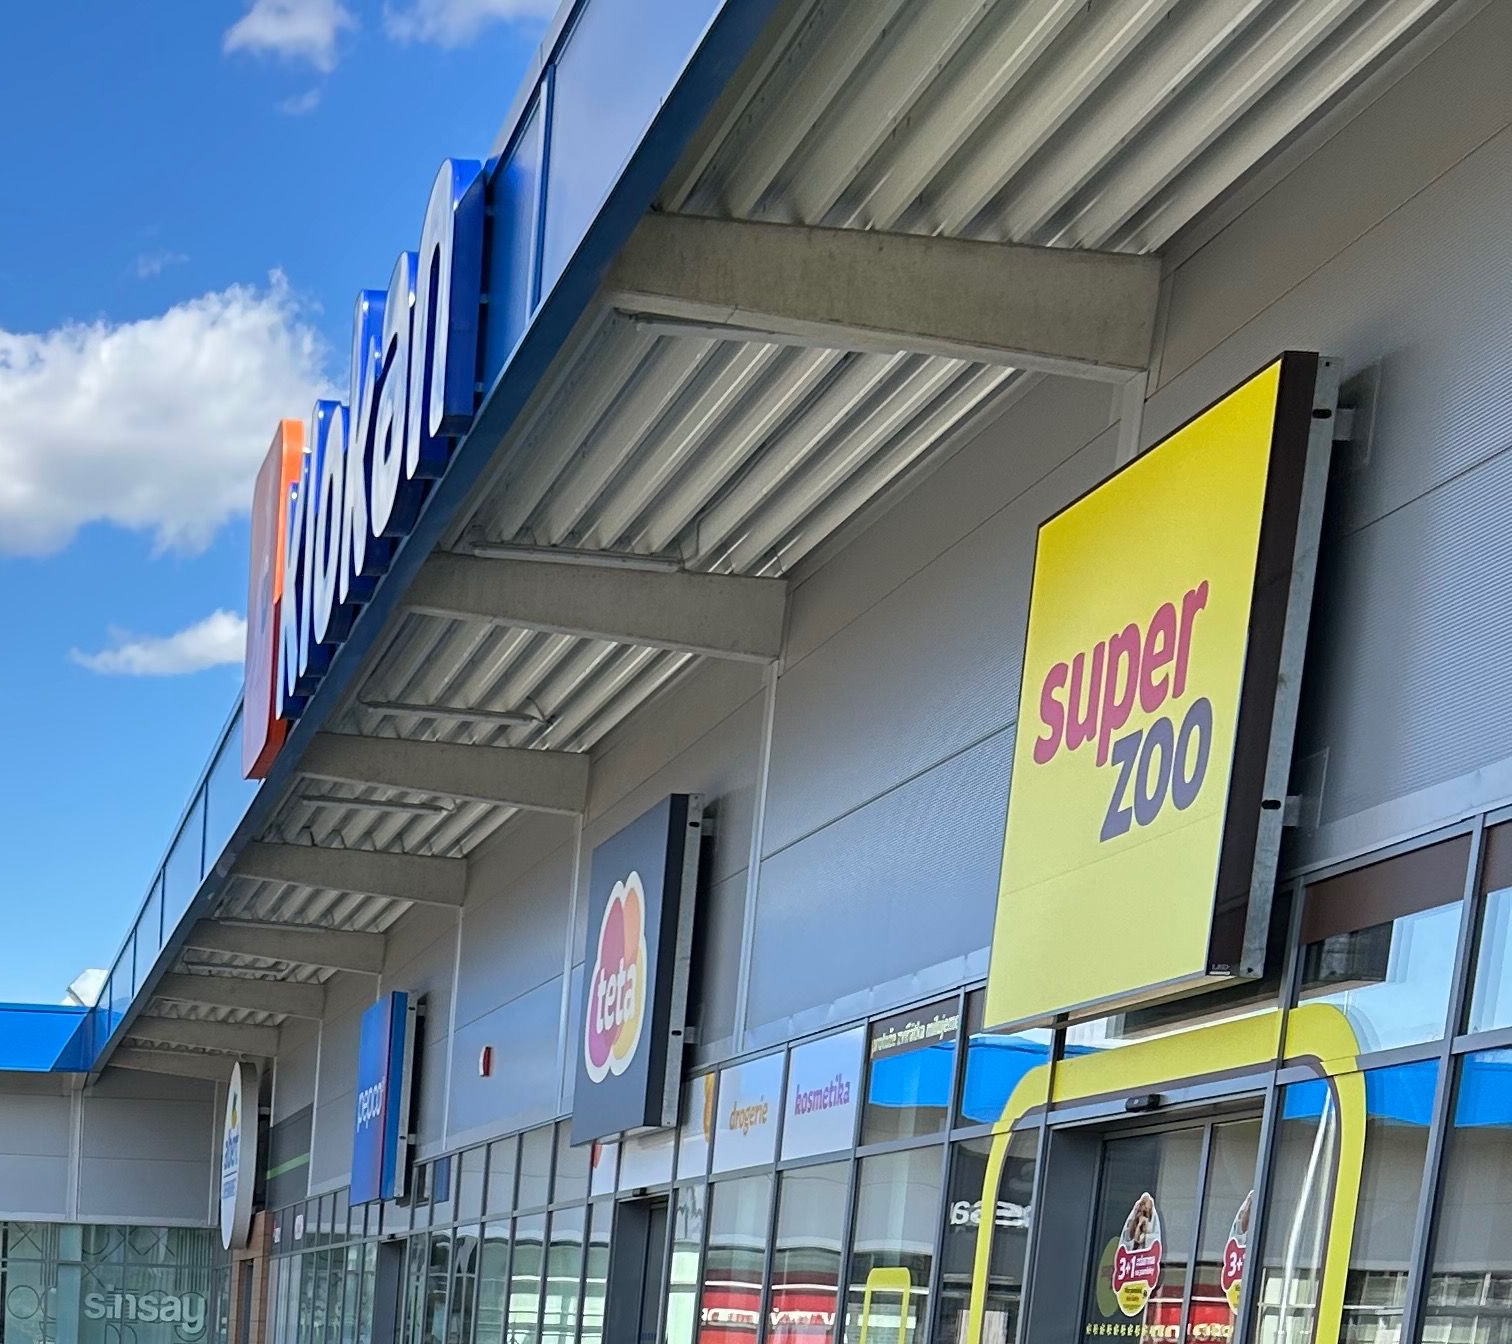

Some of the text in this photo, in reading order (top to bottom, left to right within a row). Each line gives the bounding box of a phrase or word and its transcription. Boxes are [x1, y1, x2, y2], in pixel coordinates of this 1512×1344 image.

[1033, 580, 1209, 767] super
[1099, 697, 1213, 843] zoo
[596, 956, 638, 1035] teta
[356, 1082, 384, 1133] pepco
[729, 1095, 768, 1136] drogerie
[794, 1073, 850, 1115] kosmetika
[1118, 1255, 1136, 1280] 3+1
[84, 1284, 205, 1334] sinsay
